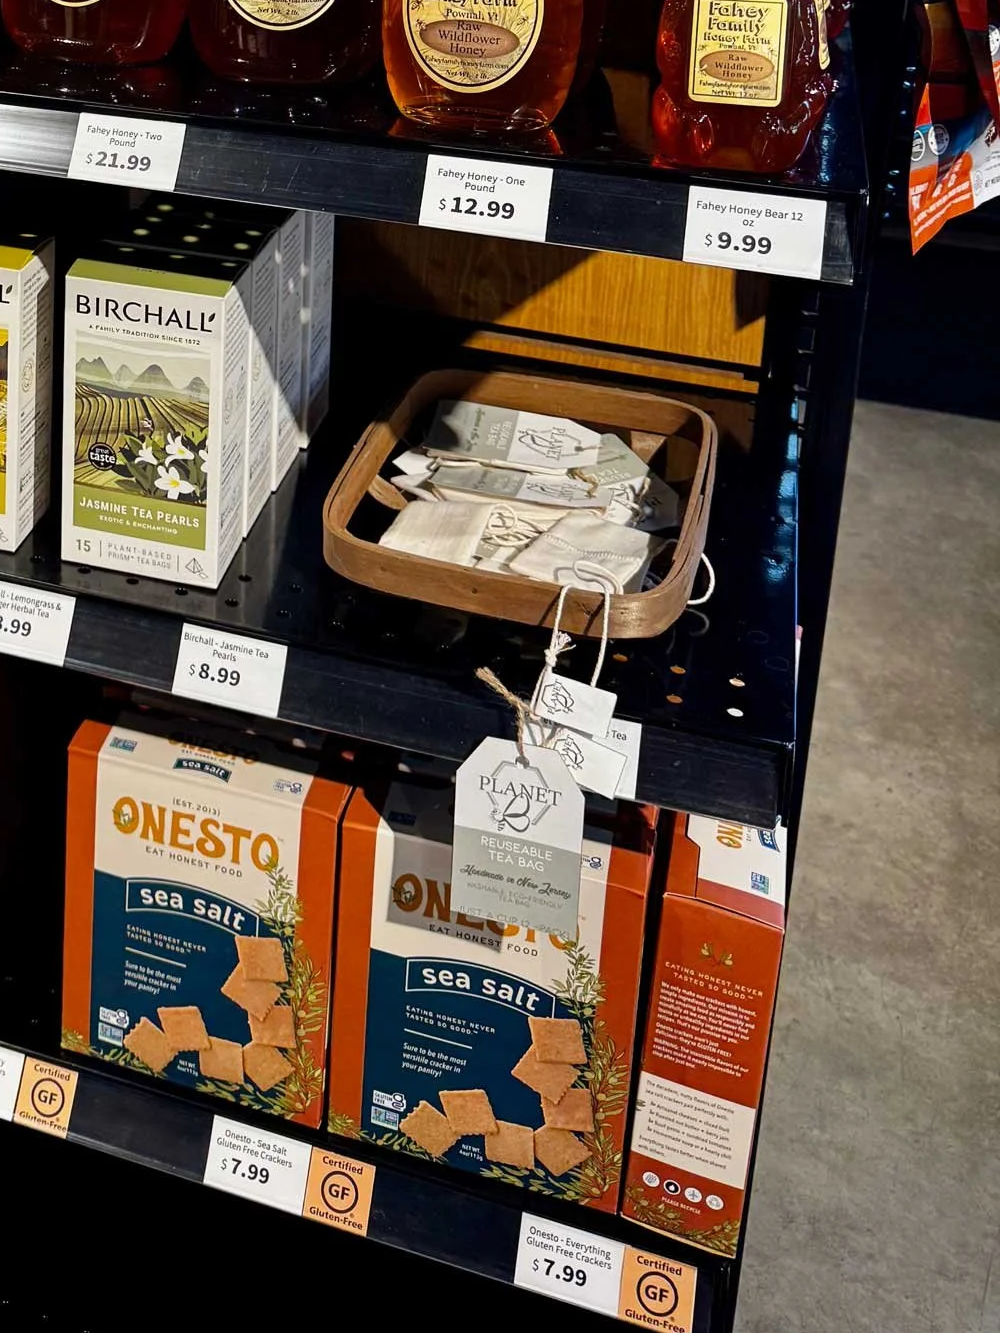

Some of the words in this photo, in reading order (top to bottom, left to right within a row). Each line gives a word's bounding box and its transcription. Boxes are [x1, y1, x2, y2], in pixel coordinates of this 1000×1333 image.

[438, 29, 501, 45] Wildflower
[457, 20, 482, 32] Raw
[450, 43, 487, 57] Honey
[437, 168, 465, 182] Fahey
[466, 170, 499, 185] Honey
[505, 176, 526, 187] One
[464, 182, 495, 194] Pound
[76, 294, 212, 334] BIRCHALL
[90, 450, 116, 465] taste
[79, 496, 128, 516] JASMINE
[132, 506, 152, 520] TEA
[157, 510, 200, 528] PEARLS
[76, 539, 91, 553] 15
[479, 775, 563, 807] PLANET
[112, 796, 280, 873] ONESTO
[481, 835, 553, 860] REUSEABLE
[145, 846, 165, 857] EAT
[169, 852, 210, 871] HONEST
[215, 864, 243, 878] FOOD
[488, 850, 513, 866] TEA
[518, 857, 544, 872] BAG
[139, 886, 184, 911] sea
[193, 898, 245, 932] salt
[422, 966, 472, 990] sea
[481, 977, 540, 1013] salt
[322, 1155, 364, 1176] Certified
[328, 1182, 350, 1201] GF
[308, 1206, 364, 1231] Gluten-Free
[526, 1237, 554, 1252] Gluten
[555, 1245, 574, 1258] Free
[576, 1251, 612, 1270] Crackers
[529, 1226, 559, 1243] Onesto
[566, 1238, 611, 1261] Everything
[637, 1255, 682, 1277] Certified
[645, 1285, 669, 1303] GF
[625, 1309, 685, 1333] Gluten-Free
